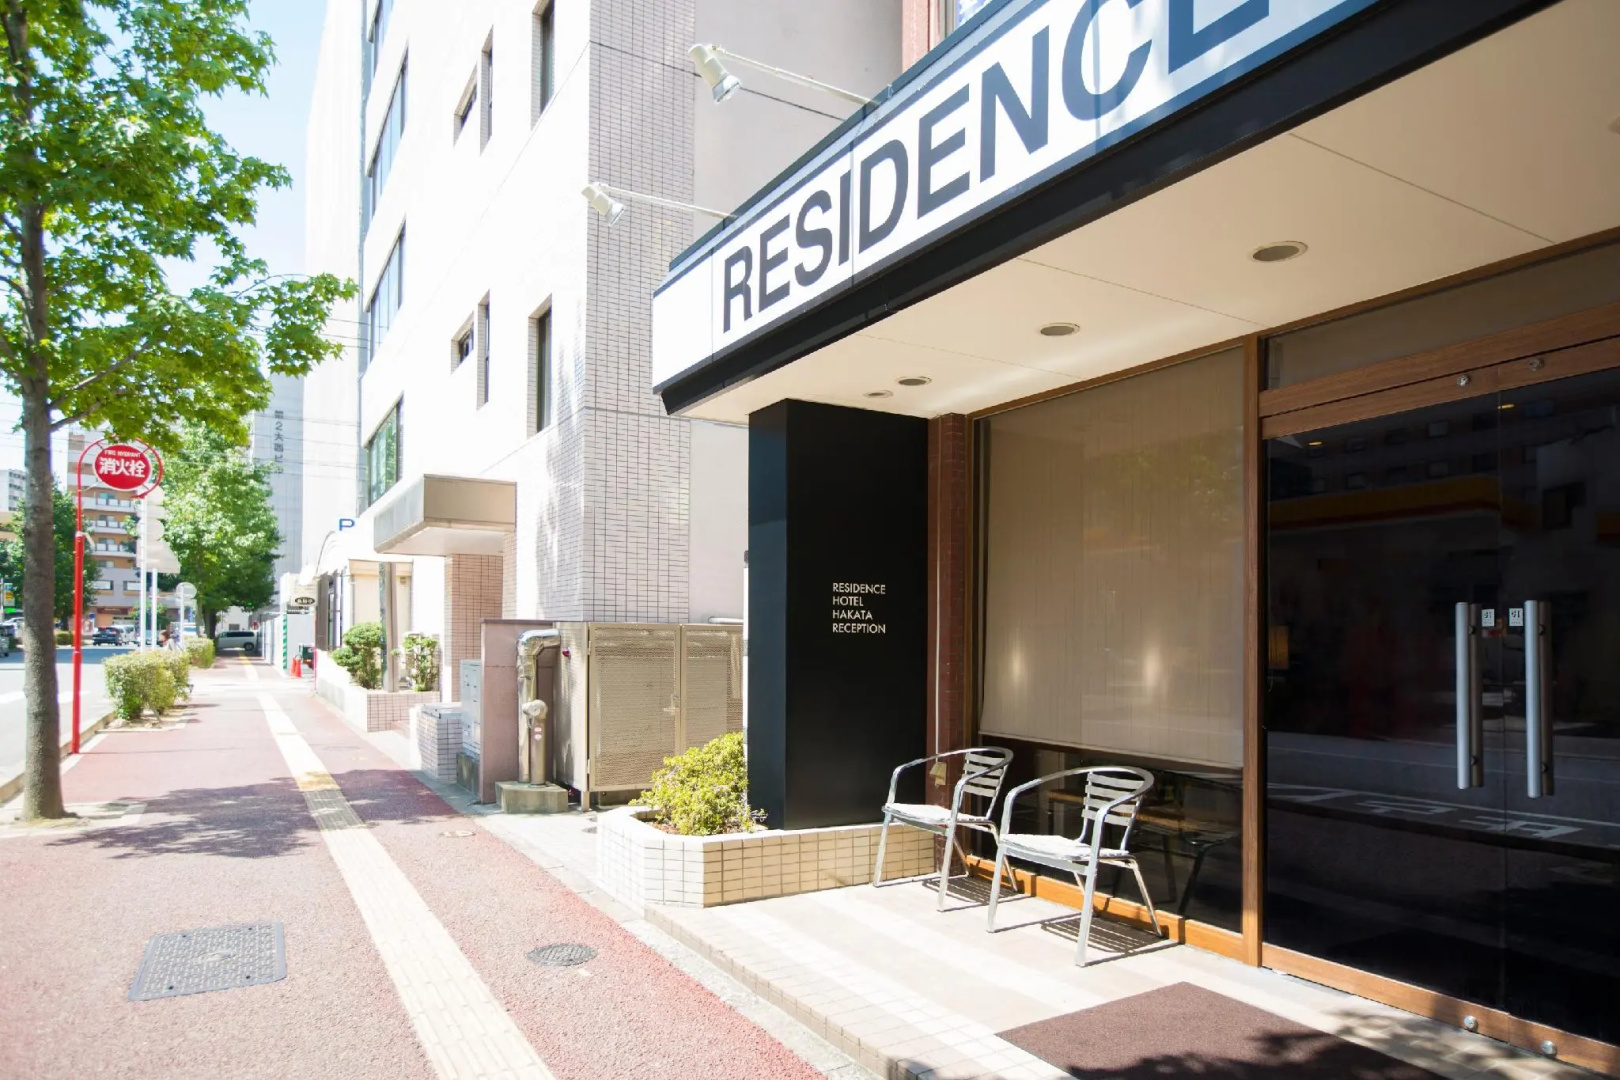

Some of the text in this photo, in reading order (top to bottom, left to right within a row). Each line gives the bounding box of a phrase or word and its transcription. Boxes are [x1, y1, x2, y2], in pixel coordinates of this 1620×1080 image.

[99, 457, 146, 478] 消火栓
[339, 518, 355, 531] P
[832, 582, 886, 595] RESIDENCE
[832, 595, 864, 607] HOTEL
[832, 609, 873, 620] HAKATA
[832, 622, 886, 634] RECEPTION
